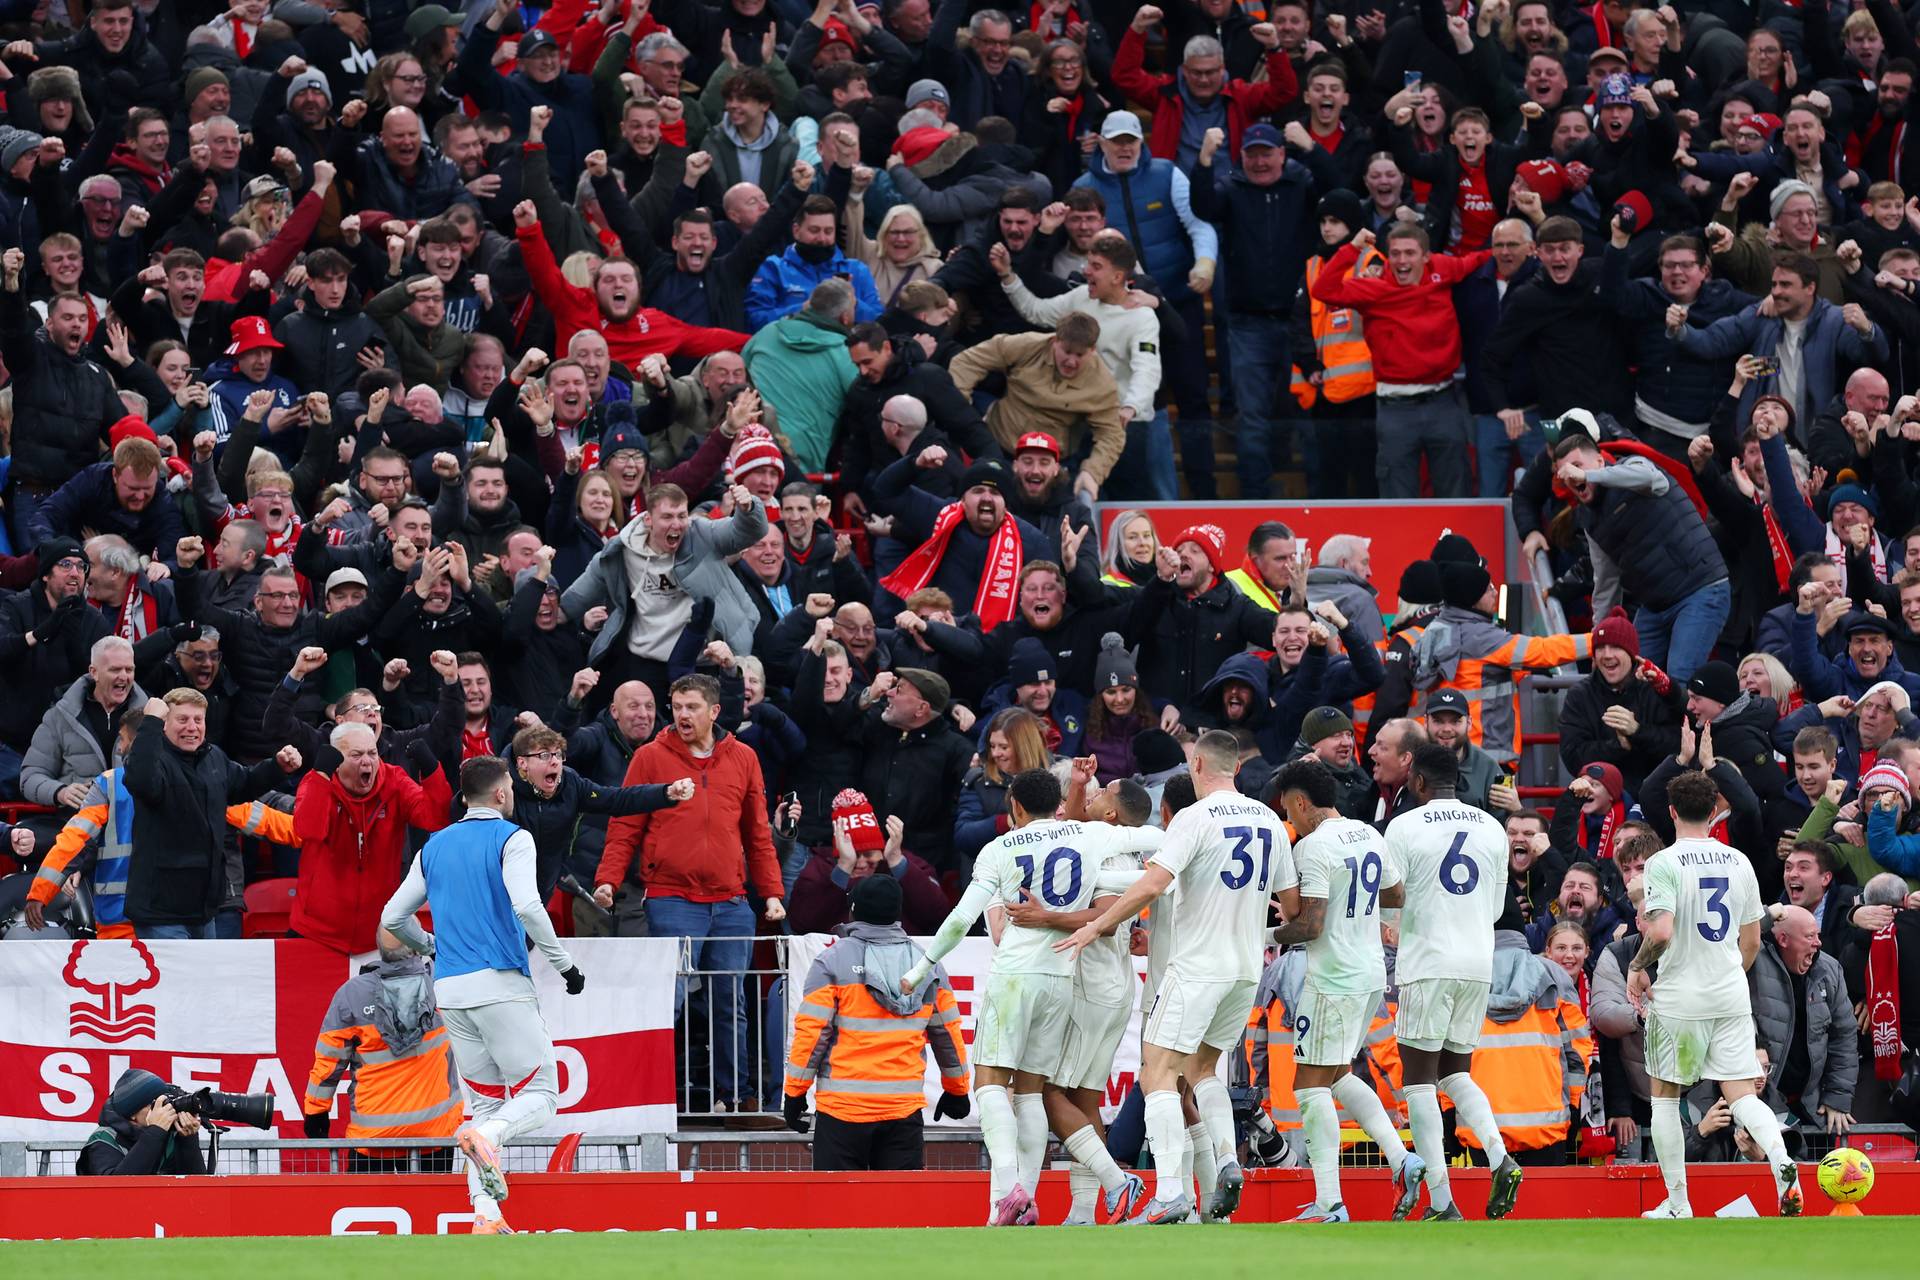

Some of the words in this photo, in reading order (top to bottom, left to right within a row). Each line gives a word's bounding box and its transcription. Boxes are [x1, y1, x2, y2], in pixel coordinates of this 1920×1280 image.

[1464, 201, 1494, 211] nex
[1003, 823, 1083, 848] GIBBS-WHITE
[1220, 826, 1273, 892] 31
[1439, 831, 1479, 896] 6
[1678, 852, 1740, 867] WILLIAMS
[1015, 847, 1083, 907] 10
[1344, 851, 1382, 918] 19
[1696, 877, 1731, 942] 3
